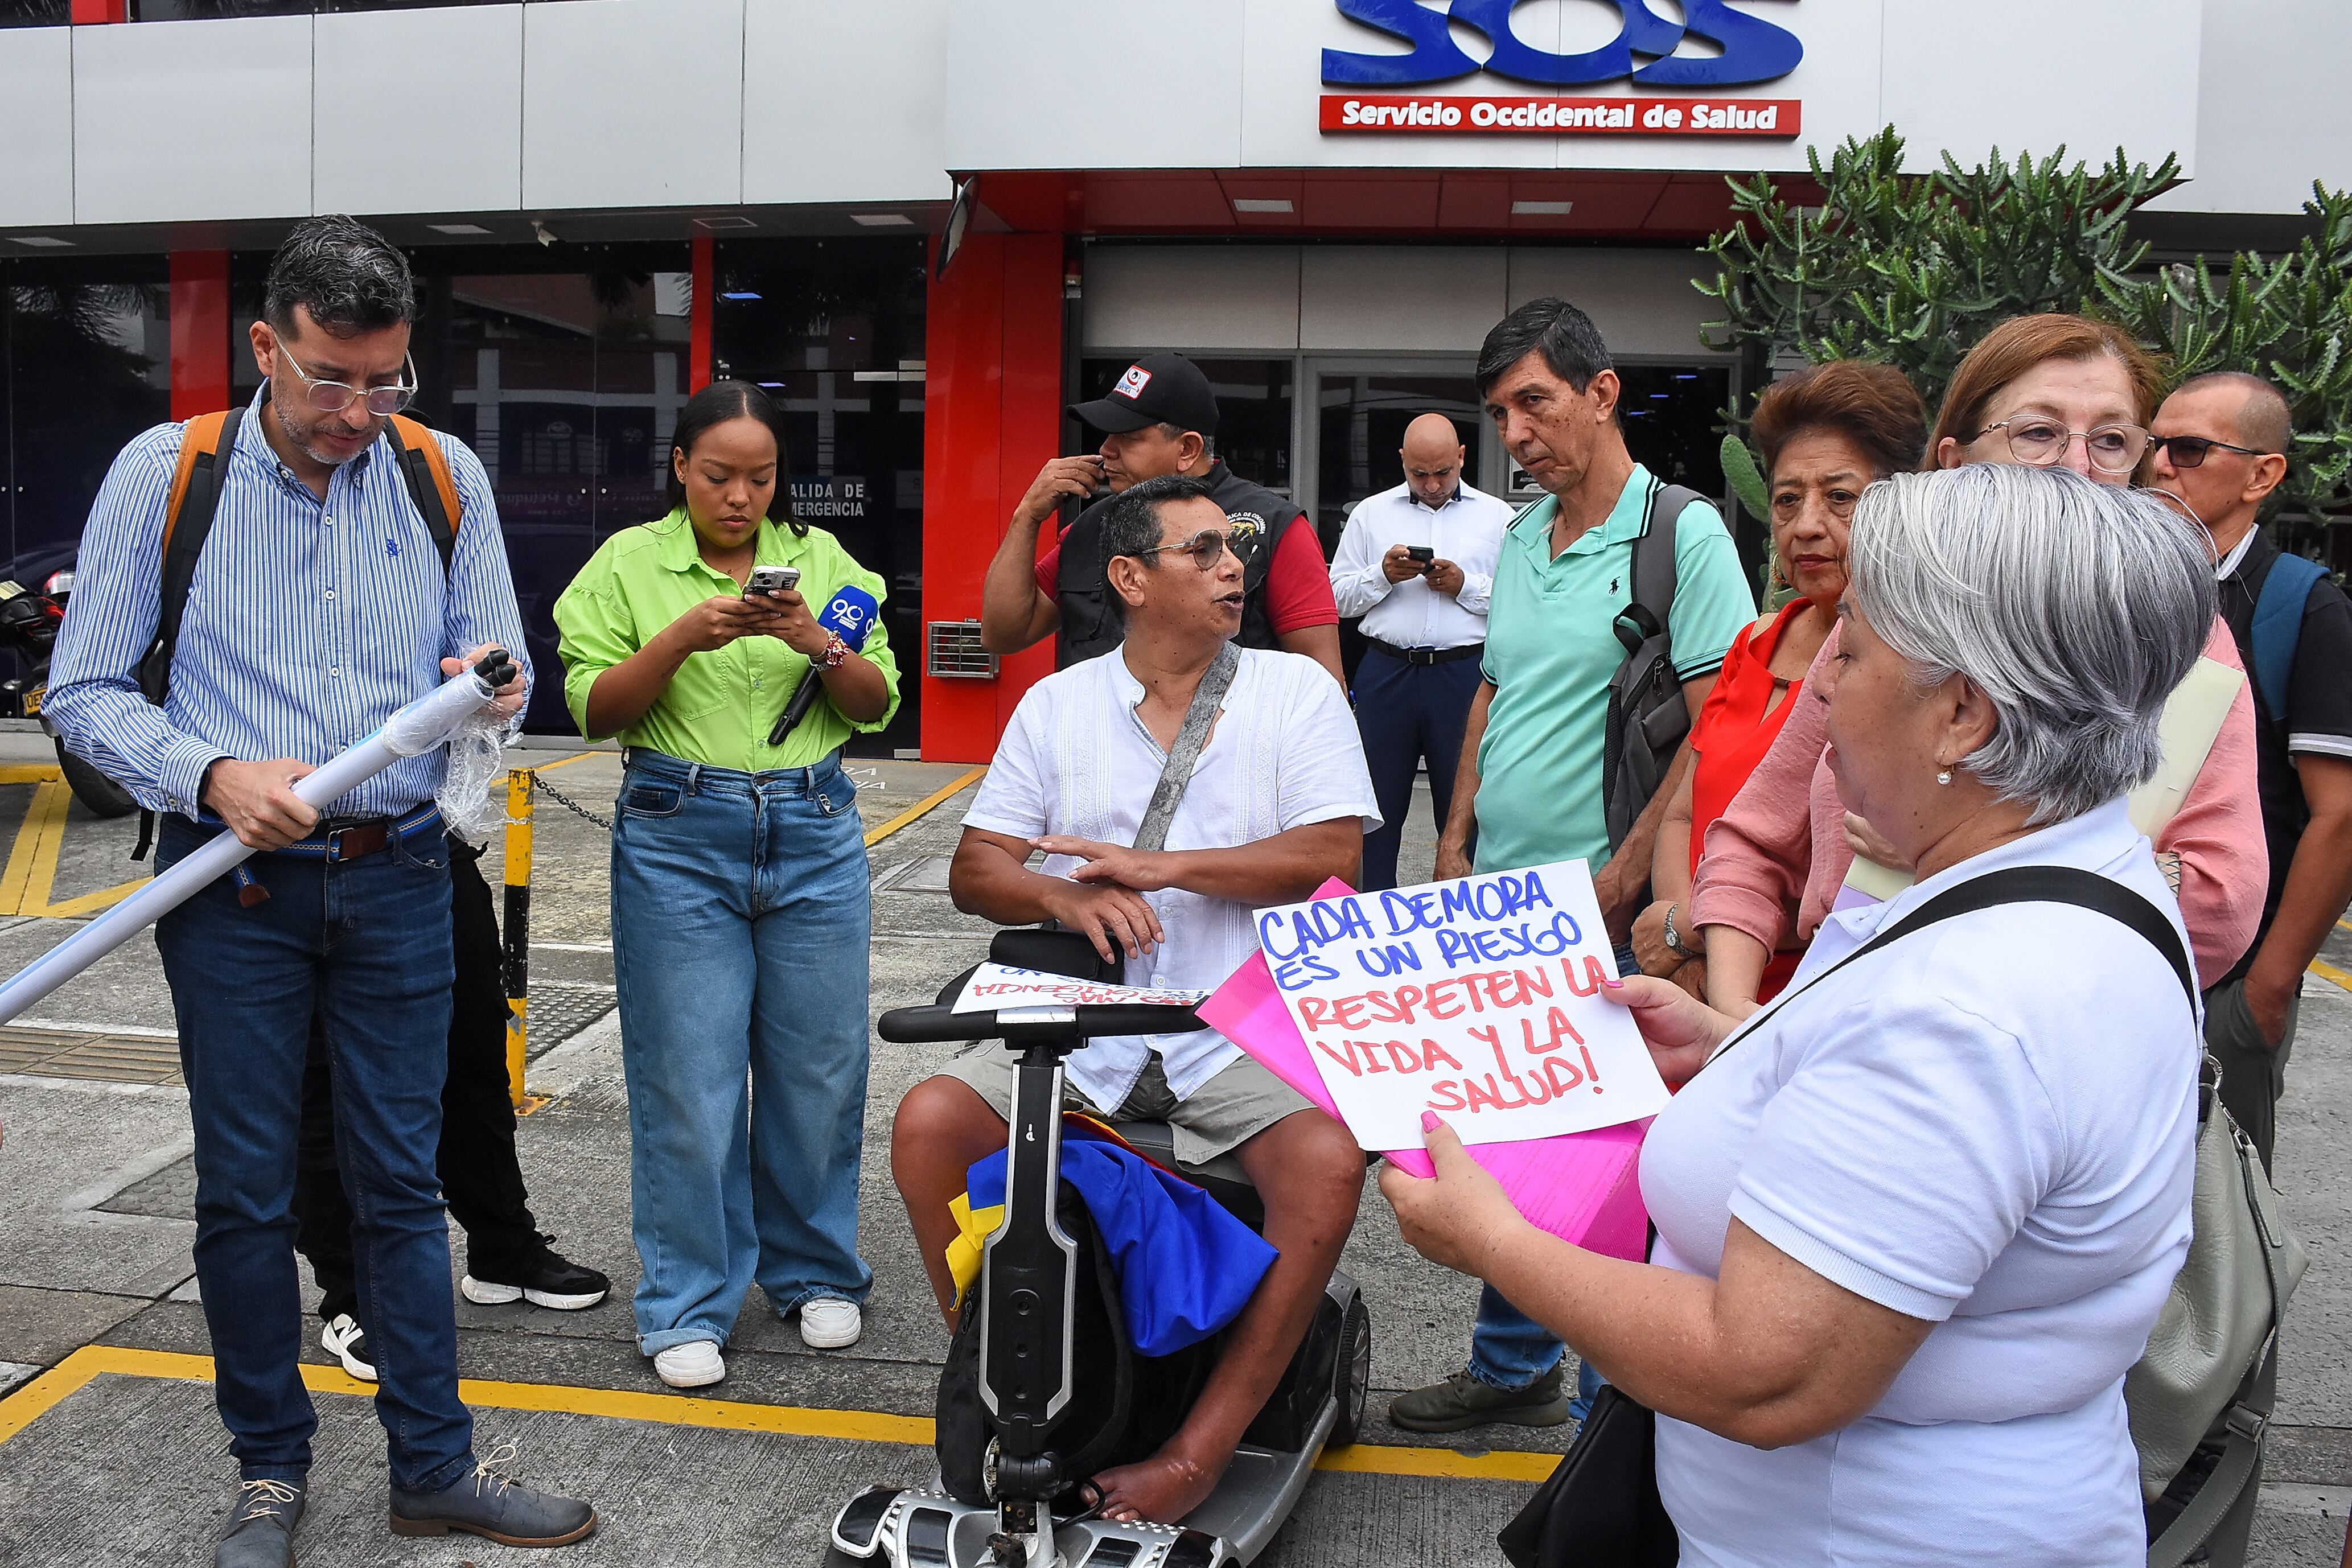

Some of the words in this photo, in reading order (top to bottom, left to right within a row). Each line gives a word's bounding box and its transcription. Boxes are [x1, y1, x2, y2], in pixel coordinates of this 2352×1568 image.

[1321, 0, 1803, 85] SOS
[1342, 101, 1461, 126] Servicio
[1470, 102, 1635, 129] Occidental
[1643, 104, 1683, 129] de
[1691, 104, 1778, 130] Salud
[791, 484, 833, 497] ALIDA
[845, 484, 864, 497] DE
[792, 502, 864, 516] MERGENCIA
[832, 599, 864, 621] 90
[862, 618, 874, 639] 9
[1260, 897, 1375, 960] CADA
[1379, 871, 1553, 936] DEMORA
[1274, 956, 1339, 991] ES
[1356, 941, 1422, 977] UN
[1436, 911, 1582, 969] RIESGO
[1298, 966, 1554, 1031] RESPETEN
[1561, 955, 1607, 998] LA
[1316, 1039, 1463, 1076] VIDA
[1467, 1025, 1514, 1081] Y
[1521, 1006, 1585, 1054] LA
[1425, 1046, 1603, 1113] SALUD!
